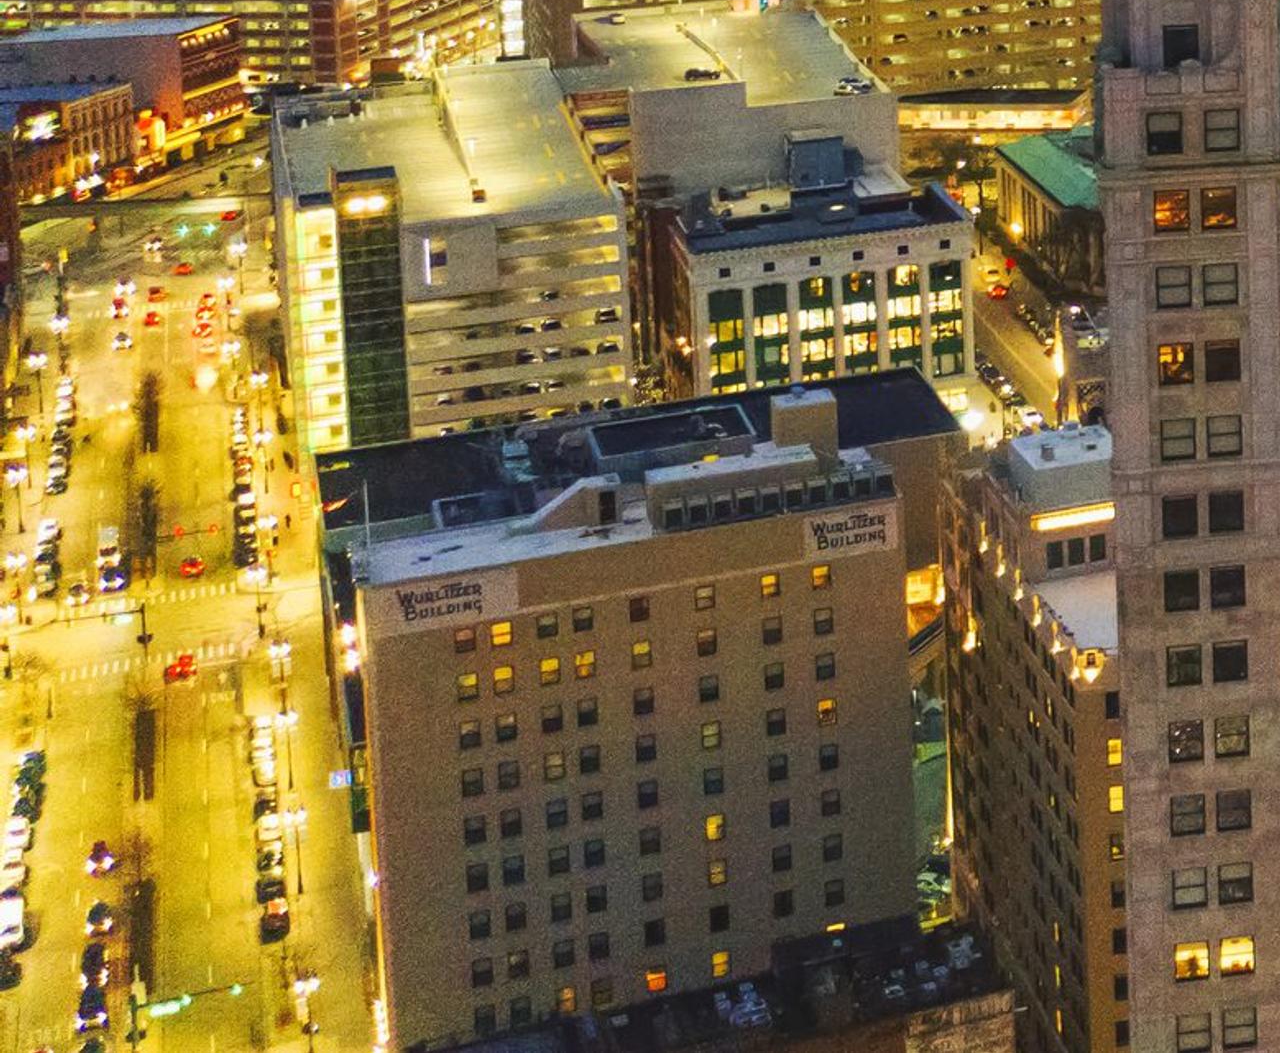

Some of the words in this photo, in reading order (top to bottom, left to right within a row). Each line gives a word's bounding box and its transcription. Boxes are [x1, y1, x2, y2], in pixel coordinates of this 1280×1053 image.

[810, 513, 887, 536] WURLITZER
[817, 530, 887, 551] BUILDING
[396, 582, 482, 607] WURLITZER
[405, 602, 483, 621] BUILDING
